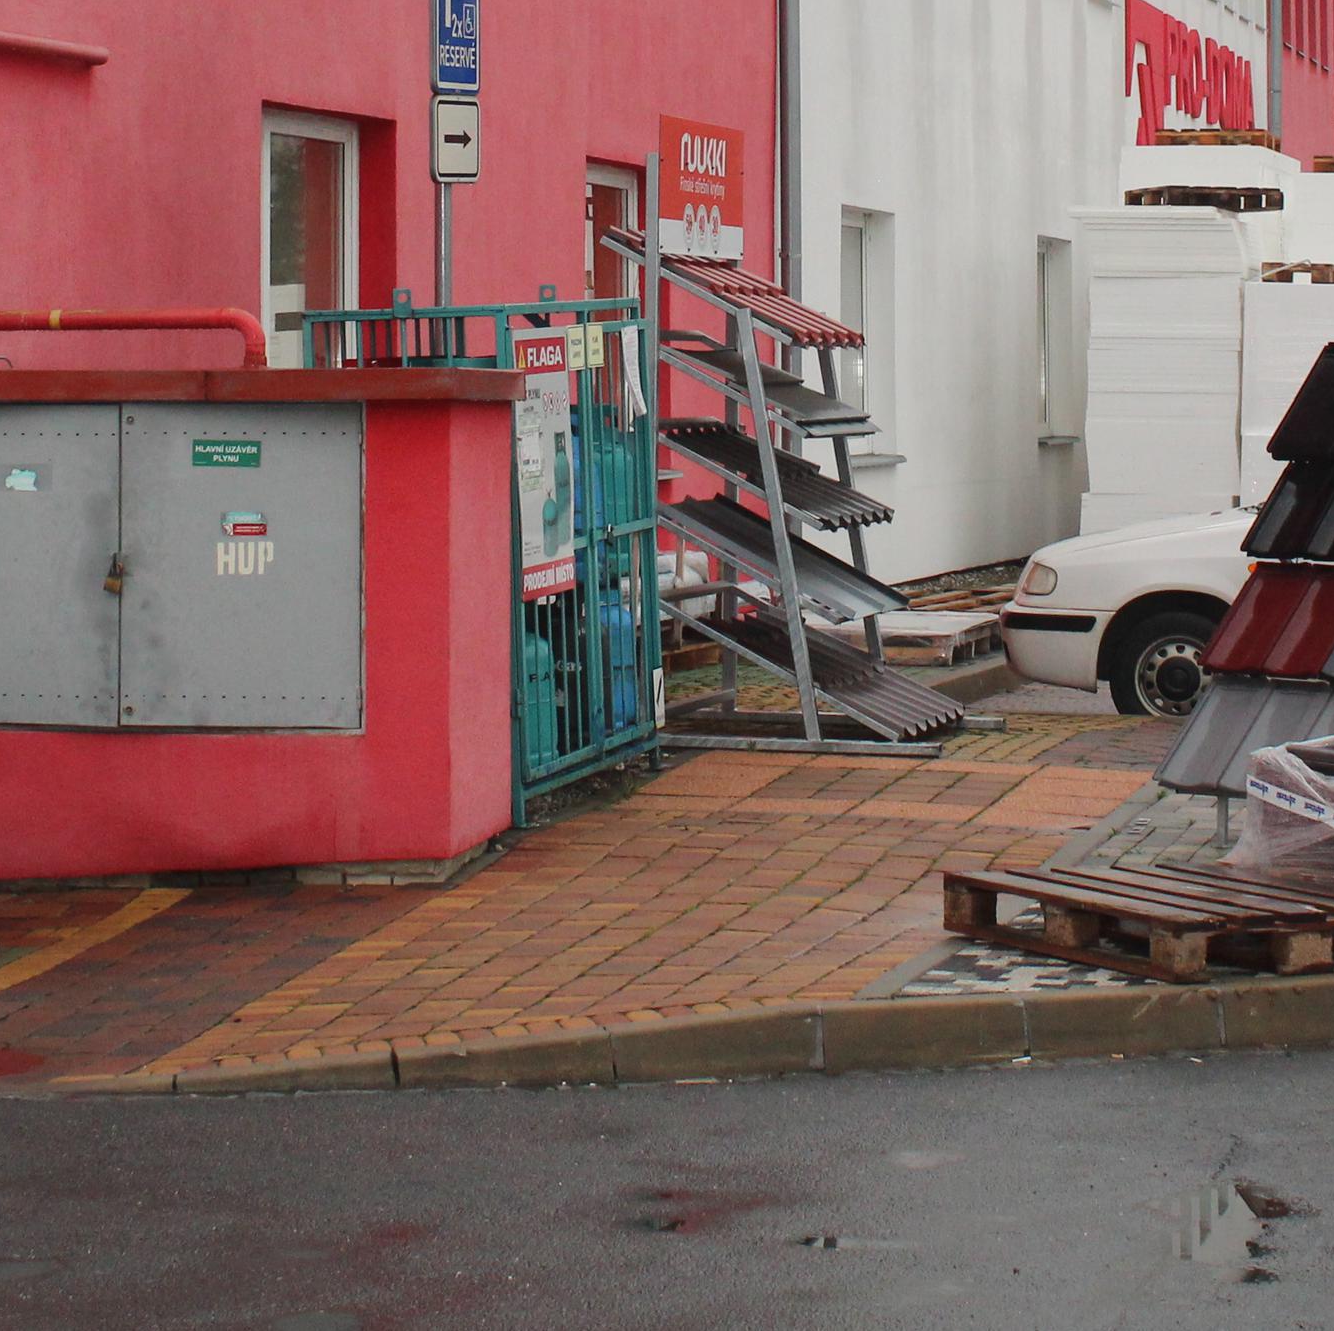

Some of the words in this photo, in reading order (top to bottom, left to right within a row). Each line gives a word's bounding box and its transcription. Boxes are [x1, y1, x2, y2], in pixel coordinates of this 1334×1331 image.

[451, 13, 464, 38] 2x
[439, 39, 476, 69] RÉSERVÉ
[527, 345, 564, 368] FLAGA
[194, 444, 225, 453] HLAVNÍ
[212, 454, 240, 463] PLYNU
[217, 541, 275, 575] HUP
